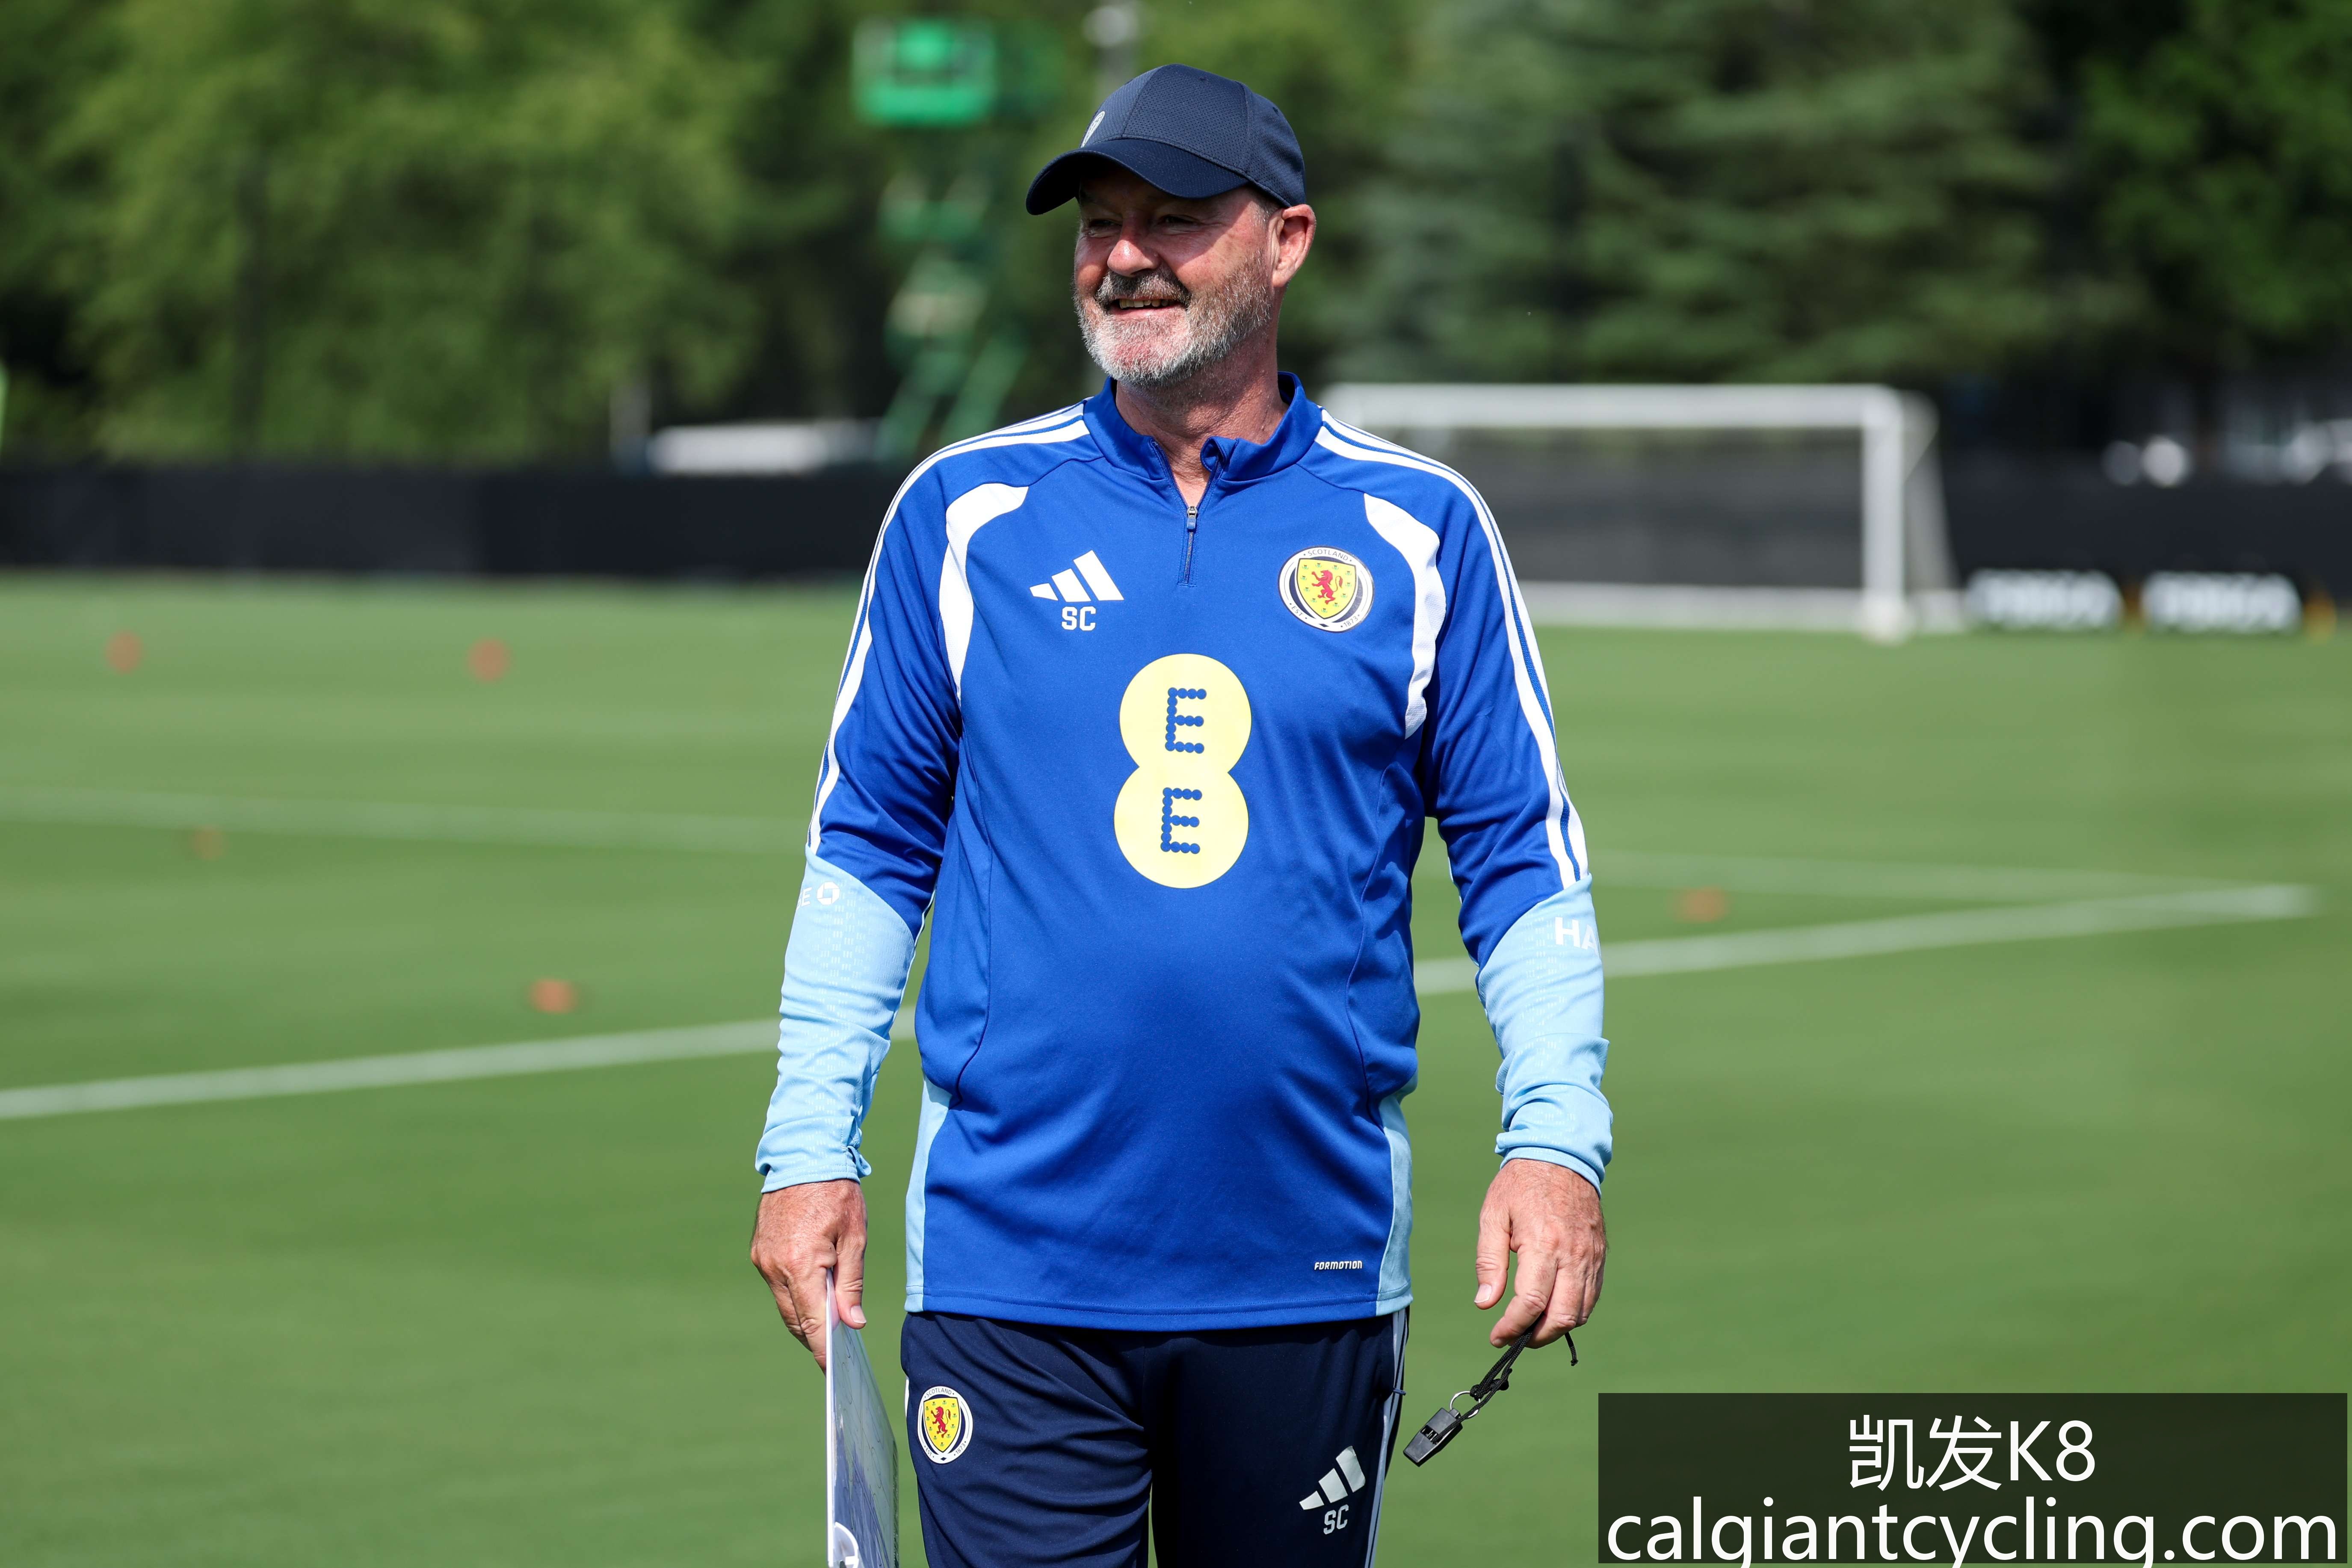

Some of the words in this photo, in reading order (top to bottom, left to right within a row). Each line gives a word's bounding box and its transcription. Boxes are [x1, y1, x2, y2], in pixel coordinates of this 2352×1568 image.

[1308, 549, 1349, 561] SCOTLAND
[1291, 605, 1303, 617] EST
[1062, 606, 1096, 631] SC
[1343, 615, 1358, 627] 1873
[1314, 1260, 1362, 1270] FORMOTION
[926, 1388, 952, 1397] SCOTLAND
[956, 1443, 966, 1454] 1873
[1323, 1504, 1349, 1535] SC
